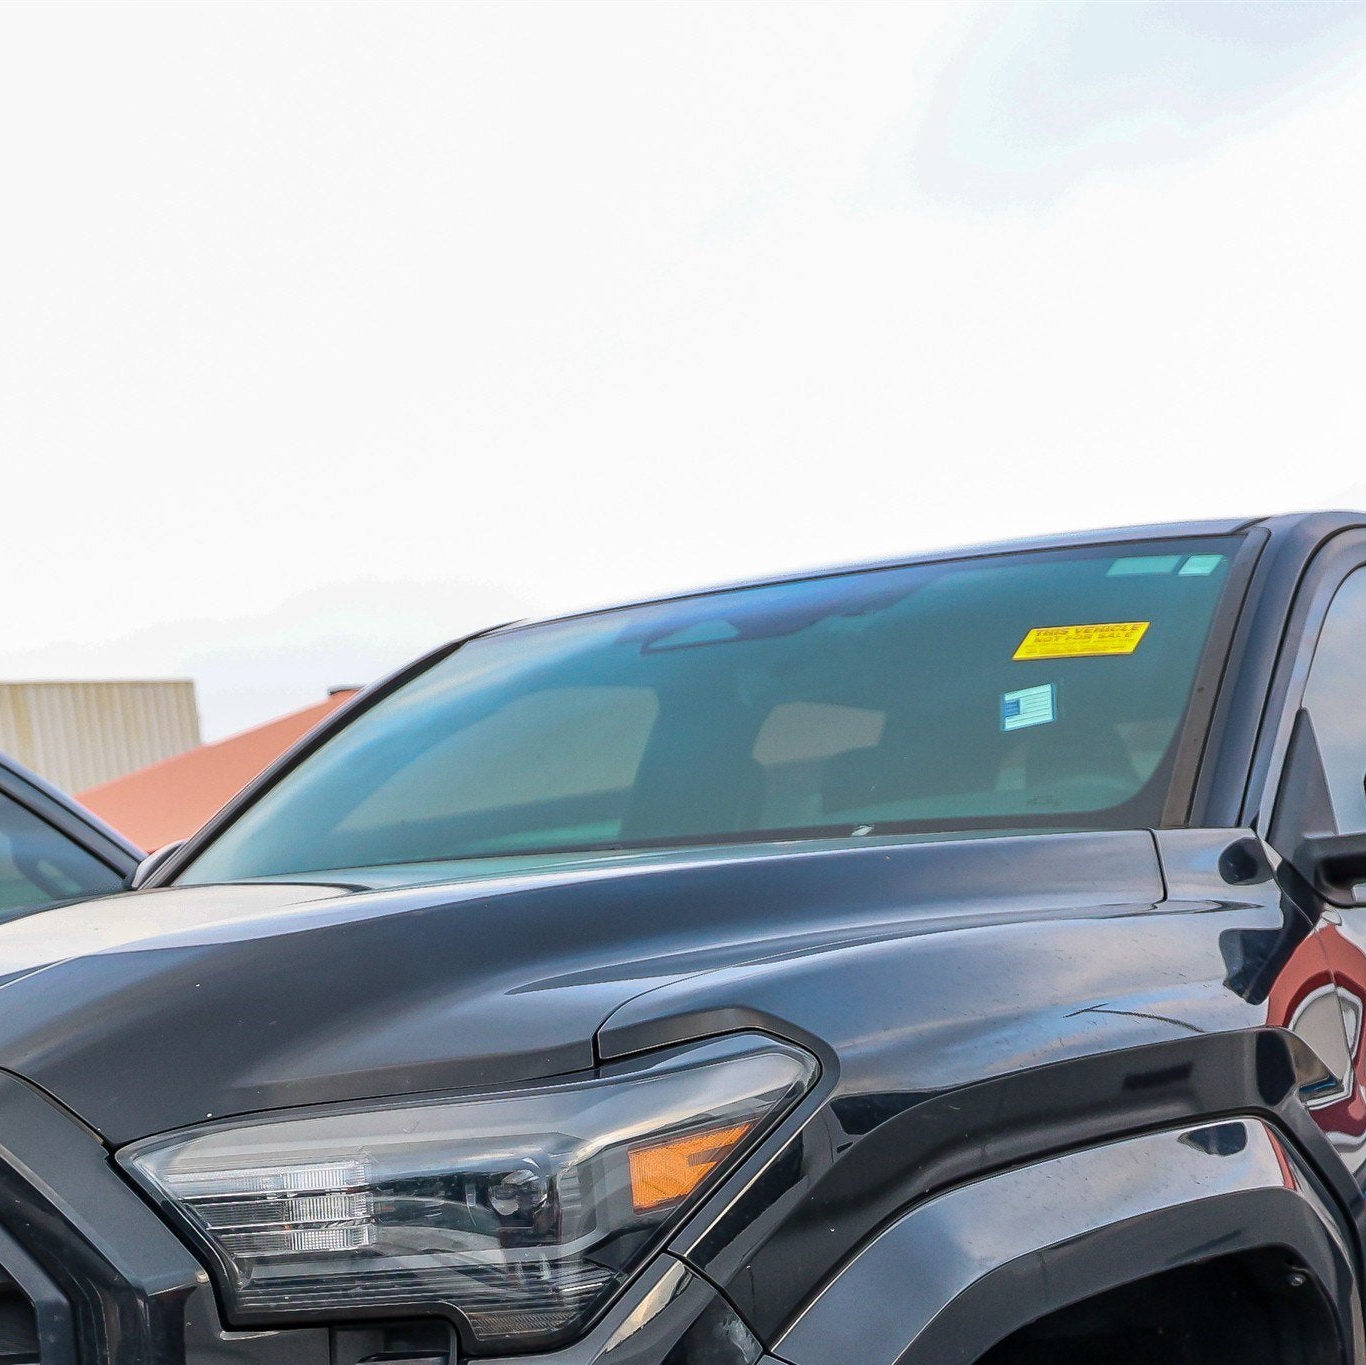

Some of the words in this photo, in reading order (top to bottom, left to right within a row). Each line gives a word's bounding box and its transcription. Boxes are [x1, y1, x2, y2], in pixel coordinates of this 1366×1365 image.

[1036, 628, 1069, 637] THIS
[1074, 624, 1140, 634] VEHICLE
[1097, 631, 1133, 639] SALE
